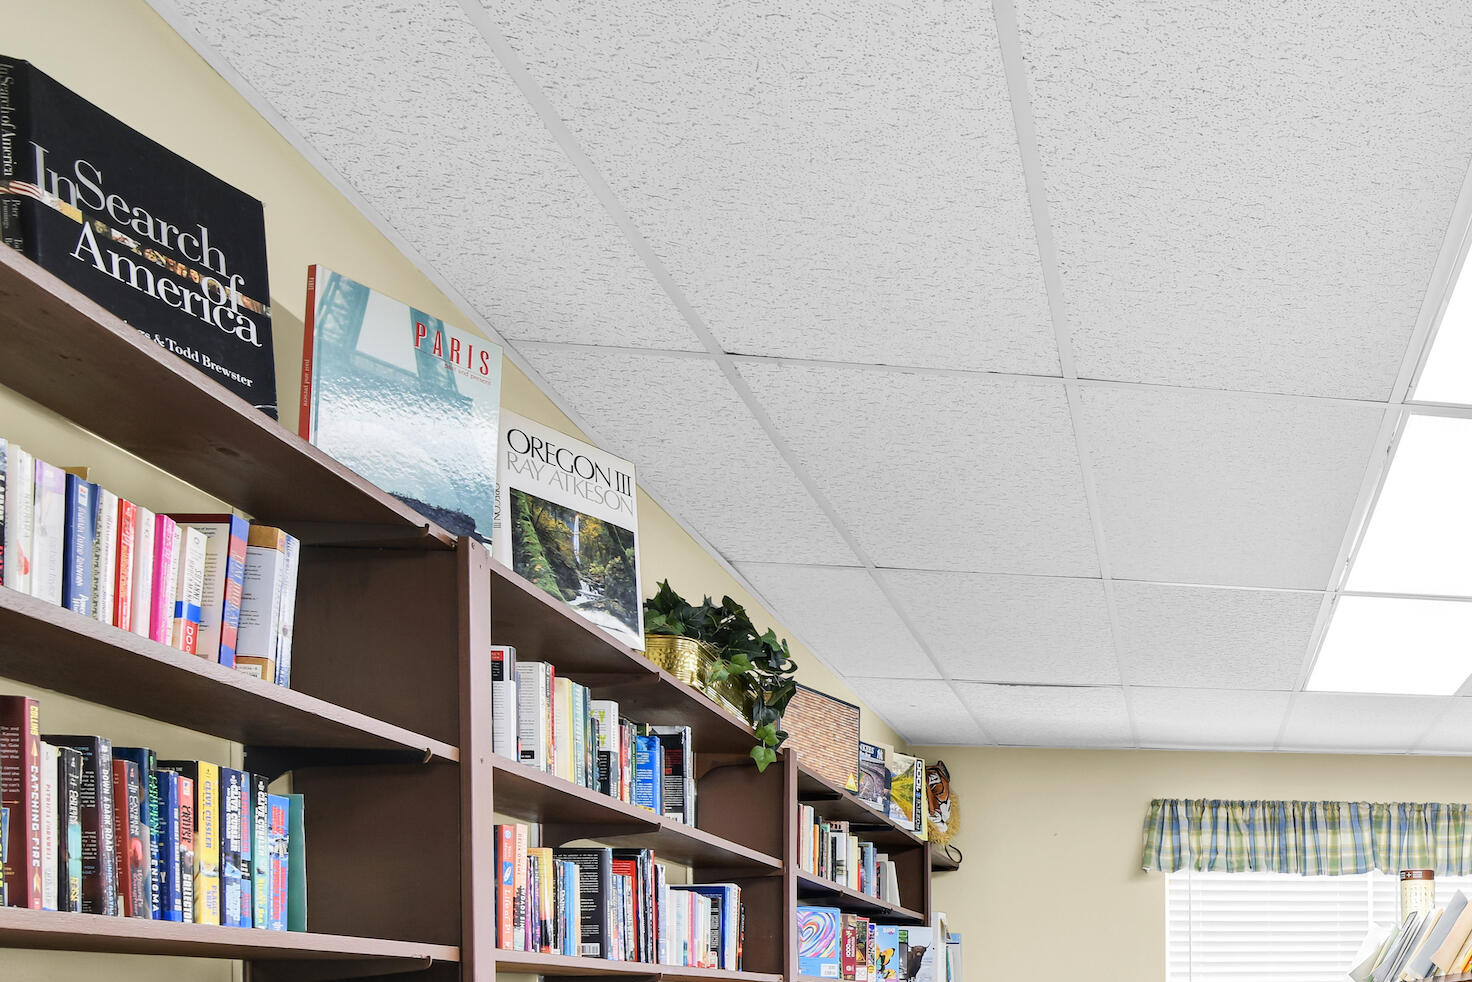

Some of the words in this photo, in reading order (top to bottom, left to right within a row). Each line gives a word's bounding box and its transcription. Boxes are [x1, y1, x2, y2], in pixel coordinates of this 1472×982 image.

[29, 141, 77, 208] In
[74, 159, 230, 278] Search
[70, 221, 262, 346] America
[202, 275, 244, 313] of
[165, 338, 199, 361] Todd
[202, 355, 252, 387] Brewster
[414, 322, 489, 376] PARIS
[507, 429, 610, 487] OREGON
[615, 470, 631, 496] III
[508, 452, 544, 480] RAY
[551, 471, 632, 516] ATKESON
[29, 706, 39, 736] COLLINS
[31, 765, 40, 831] CATCHING
[204, 781, 212, 807] CLIVE
[32, 837, 40, 867] FIRE
